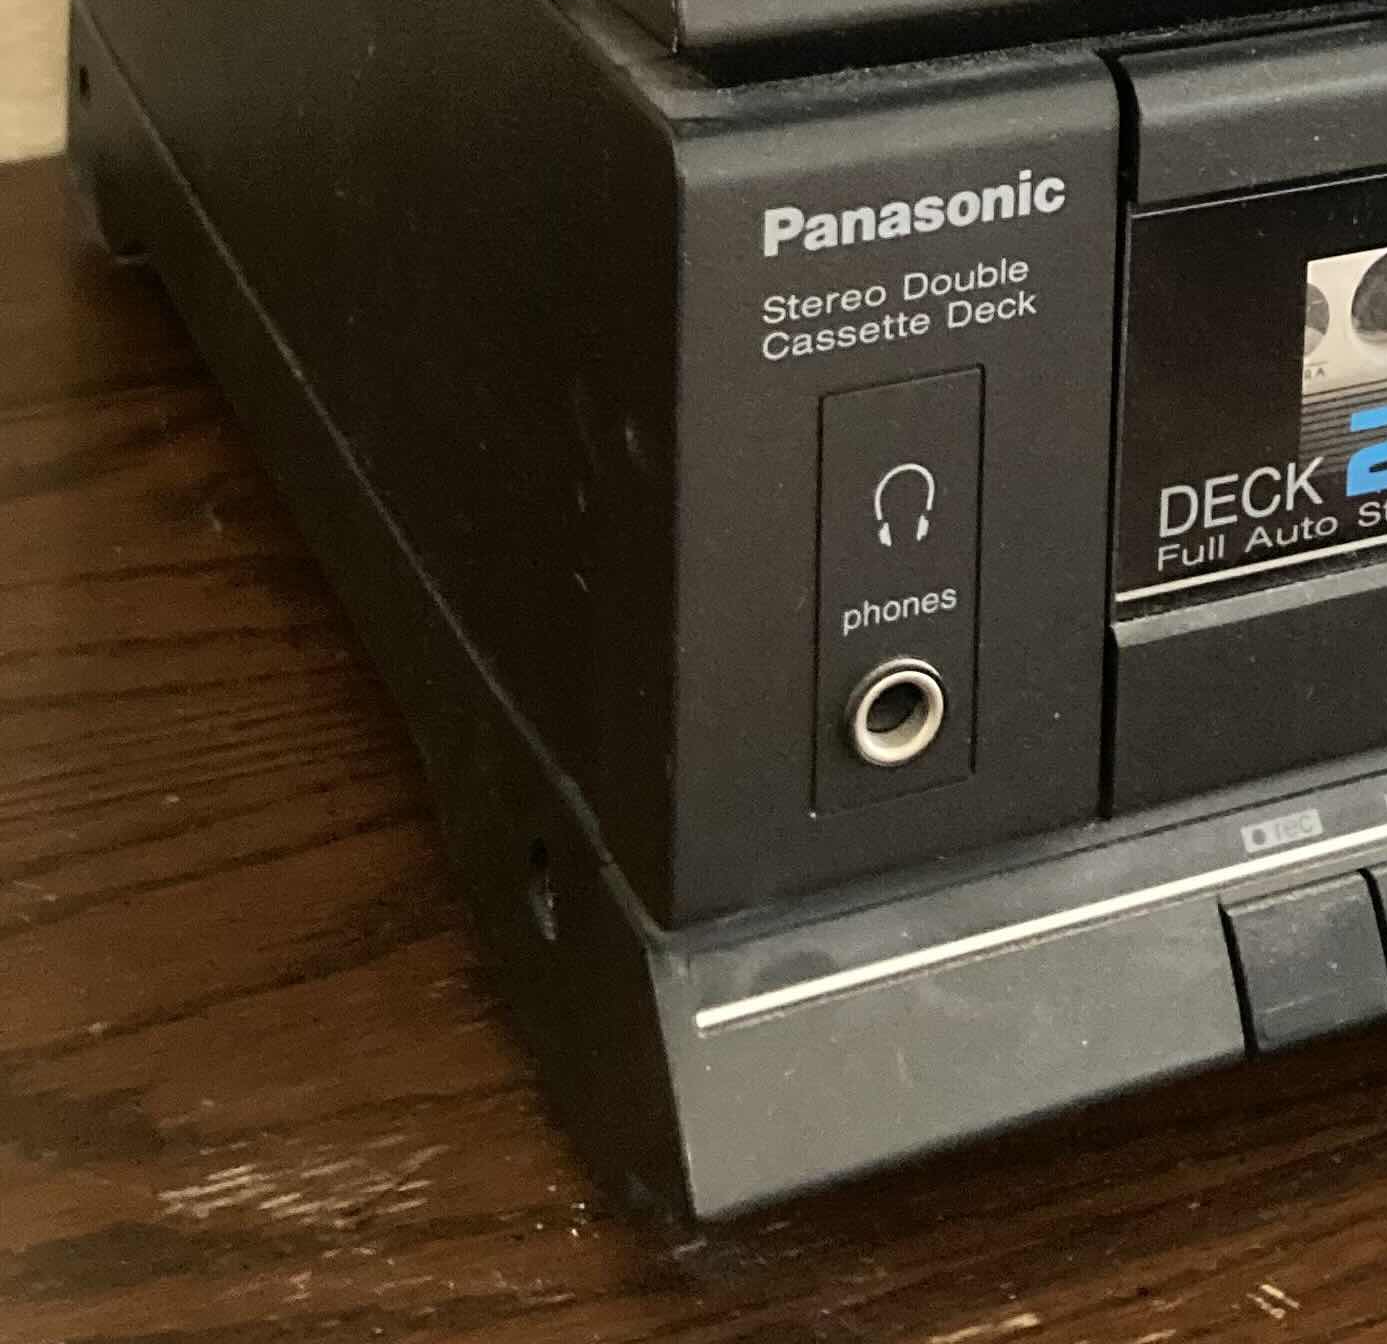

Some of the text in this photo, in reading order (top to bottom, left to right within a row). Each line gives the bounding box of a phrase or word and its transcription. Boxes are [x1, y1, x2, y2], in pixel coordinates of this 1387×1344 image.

[764, 169, 1066, 257] Panasonic
[763, 258, 1029, 324] Stereo Double
[762, 290, 1038, 361] Cassette Deck
[1159, 456, 1324, 538] DECK
[1157, 534, 1225, 572] Full
[1245, 515, 1338, 553] Auto
[842, 587, 957, 637] phones
[1274, 814, 1313, 842] rec
